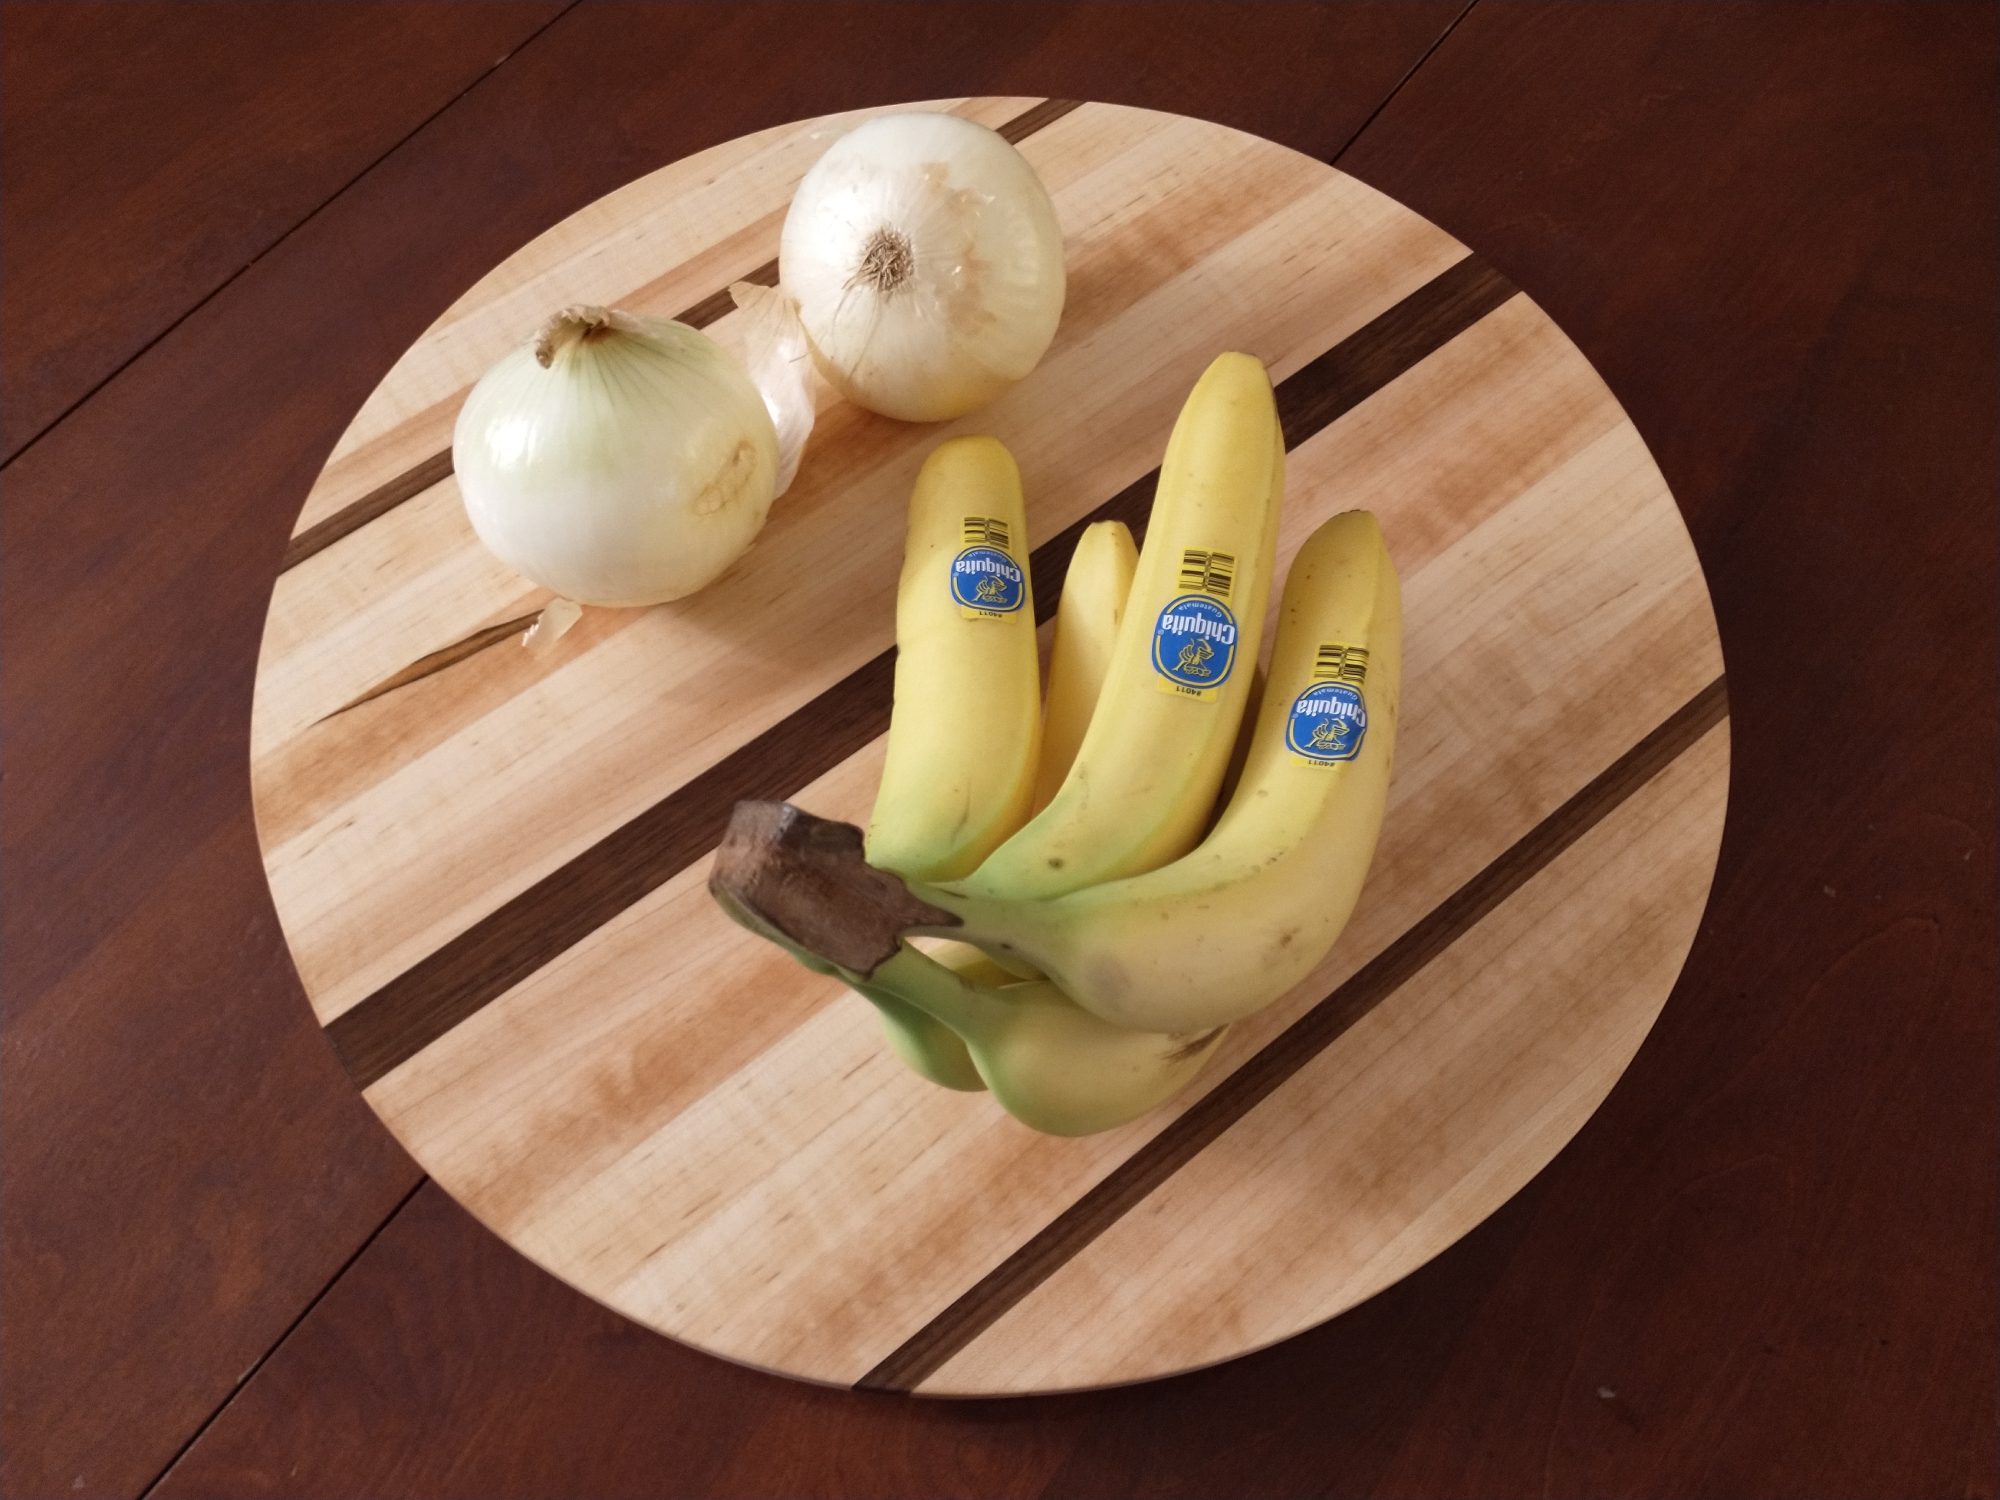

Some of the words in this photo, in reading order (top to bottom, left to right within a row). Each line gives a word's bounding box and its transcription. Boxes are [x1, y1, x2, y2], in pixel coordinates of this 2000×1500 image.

[955, 557, 1021, 583] Chiquita
[1178, 602, 1222, 618] Guatemala
[1162, 612, 1236, 646] Chiquita
[1176, 685, 1202, 697] #4011
[1313, 688, 1358, 701] Guatemala
[1296, 696, 1366, 728] Chiquita
[1308, 759, 1336, 768] #4011
